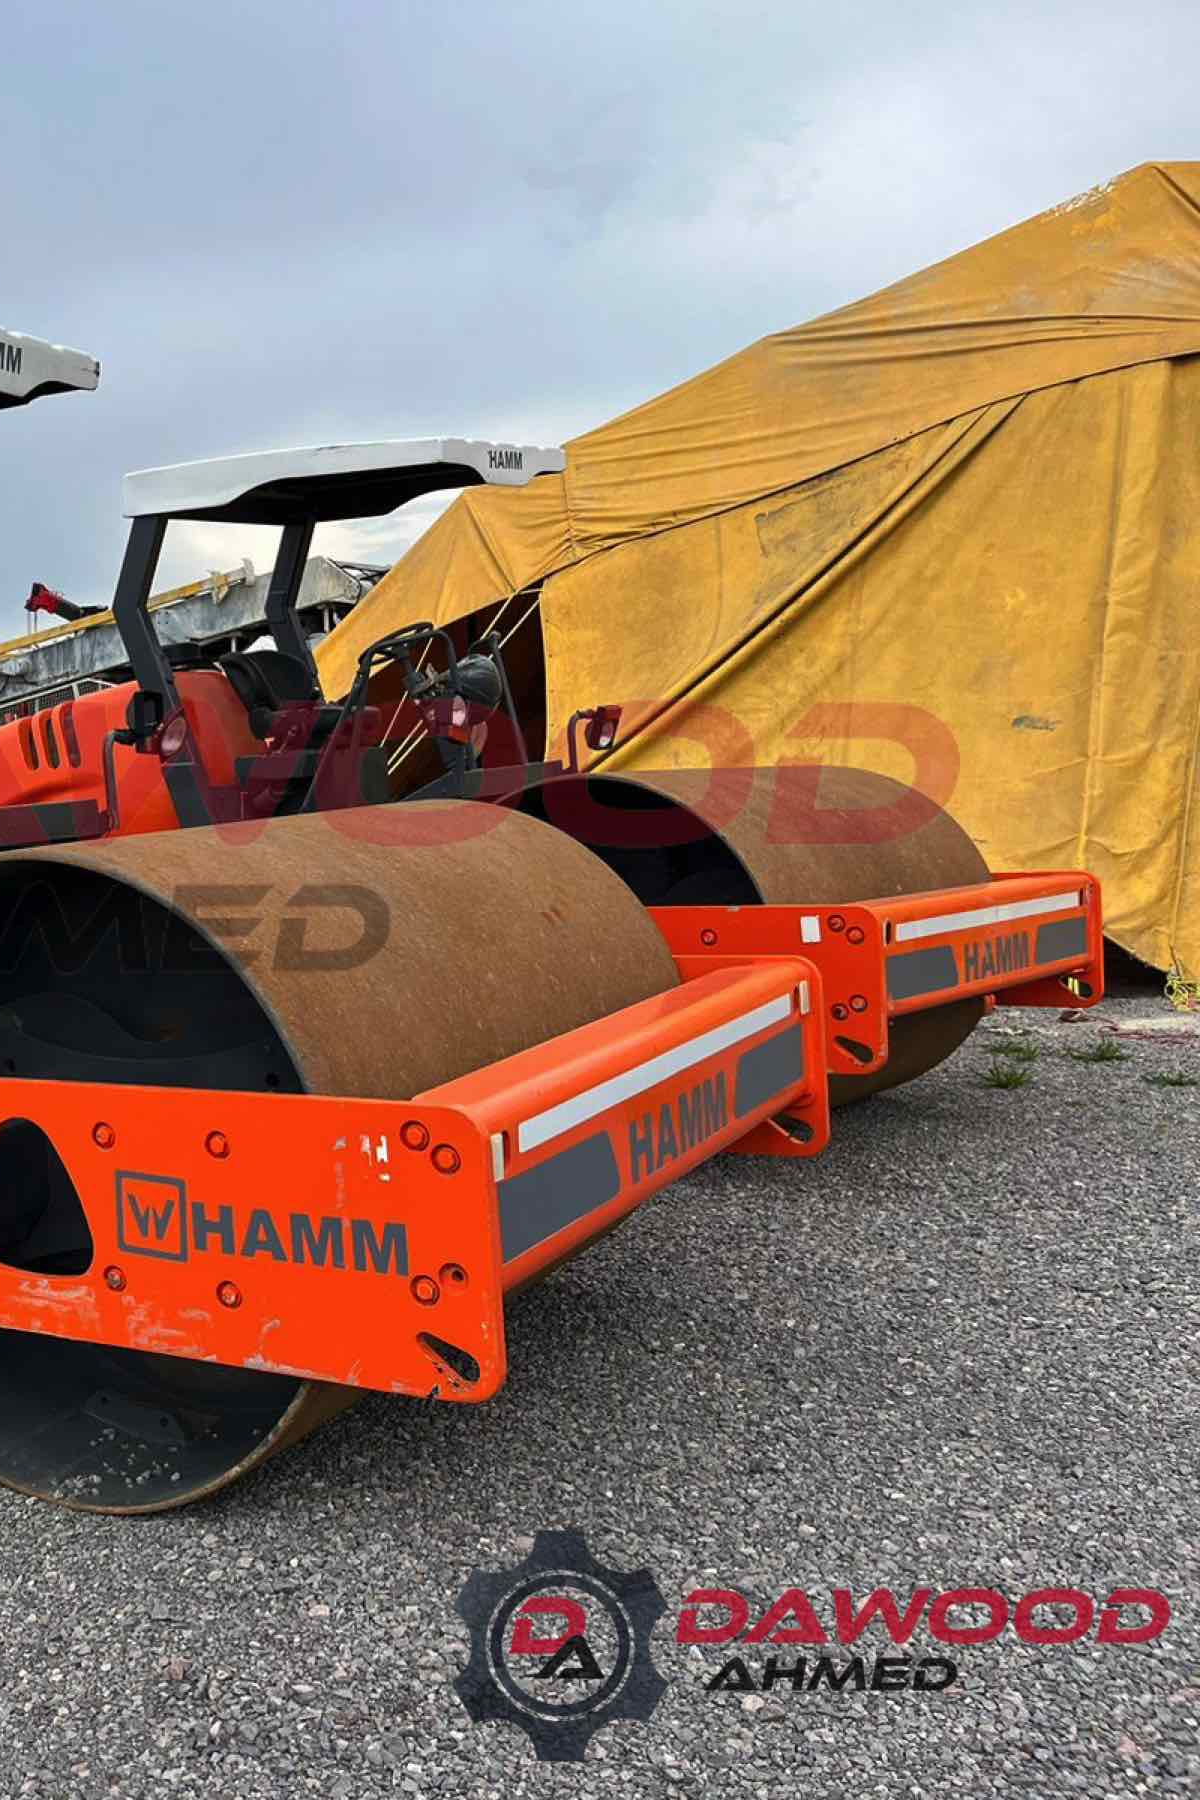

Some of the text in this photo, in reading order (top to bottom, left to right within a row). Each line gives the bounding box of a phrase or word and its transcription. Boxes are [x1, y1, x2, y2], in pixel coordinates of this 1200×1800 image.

[487, 449, 523, 470] HAMM
[964, 930, 1030, 982] HAMM
[630, 1071, 728, 1183] HAMM
[191, 1202, 410, 1277] HAMM
